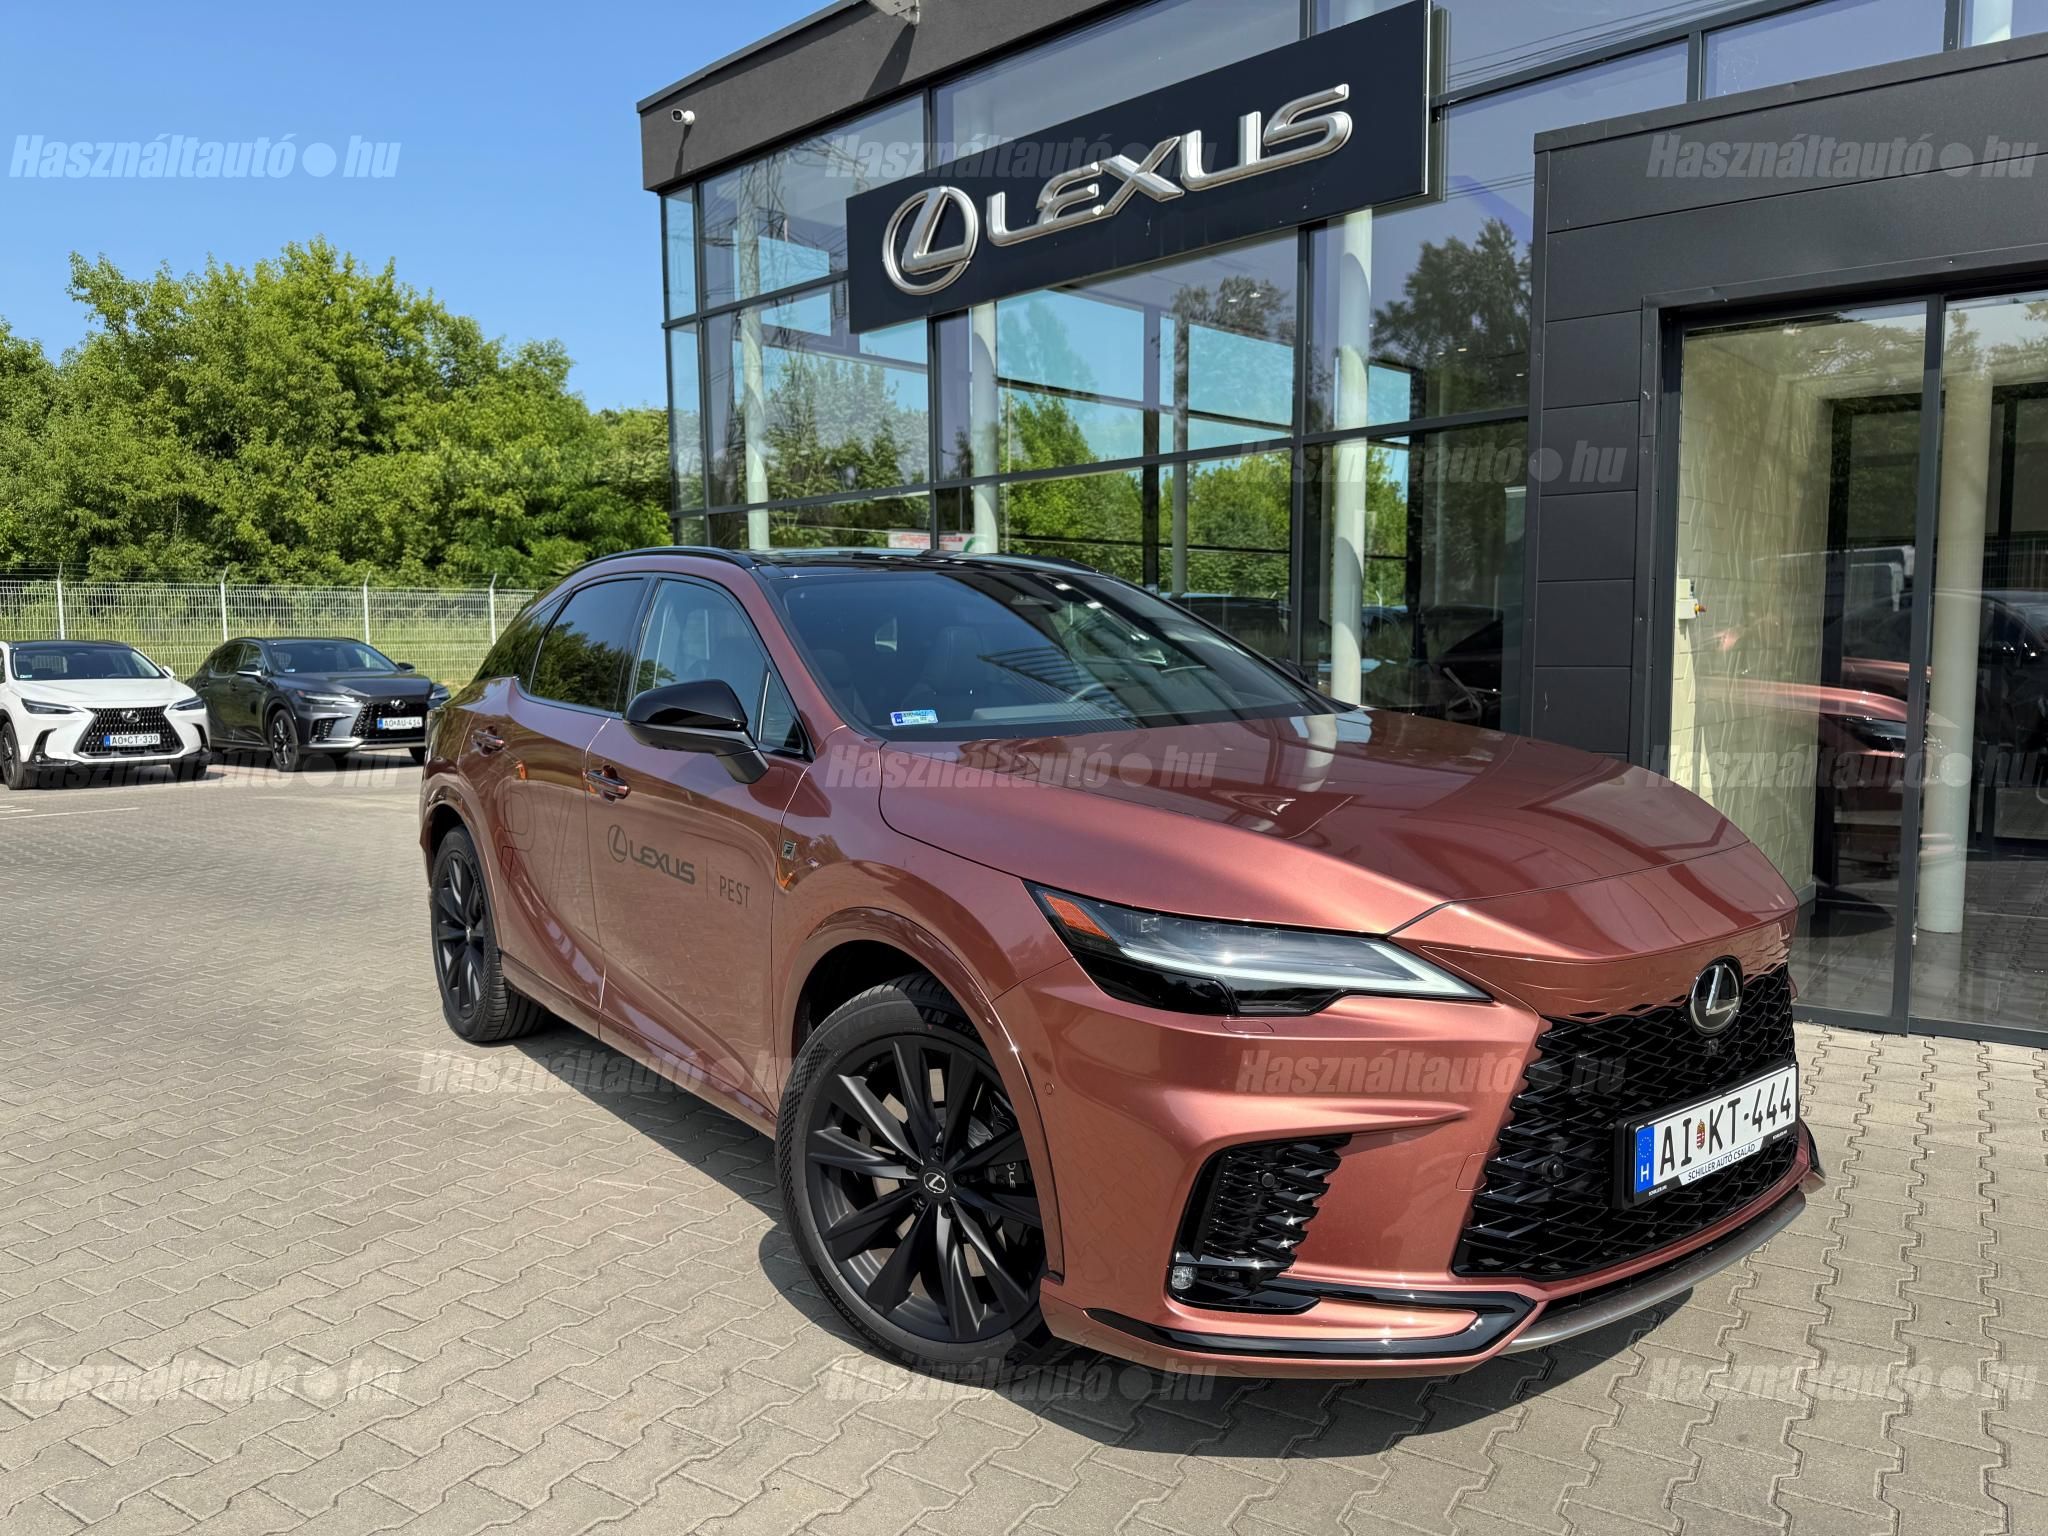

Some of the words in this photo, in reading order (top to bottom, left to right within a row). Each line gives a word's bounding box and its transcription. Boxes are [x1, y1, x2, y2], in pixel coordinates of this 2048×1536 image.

[986, 83, 1353, 247] LEXUS
[630, 840, 695, 885] LEXUS
[720, 875, 750, 908] PEST
[1688, 1162, 1716, 1181] SCHILLER
